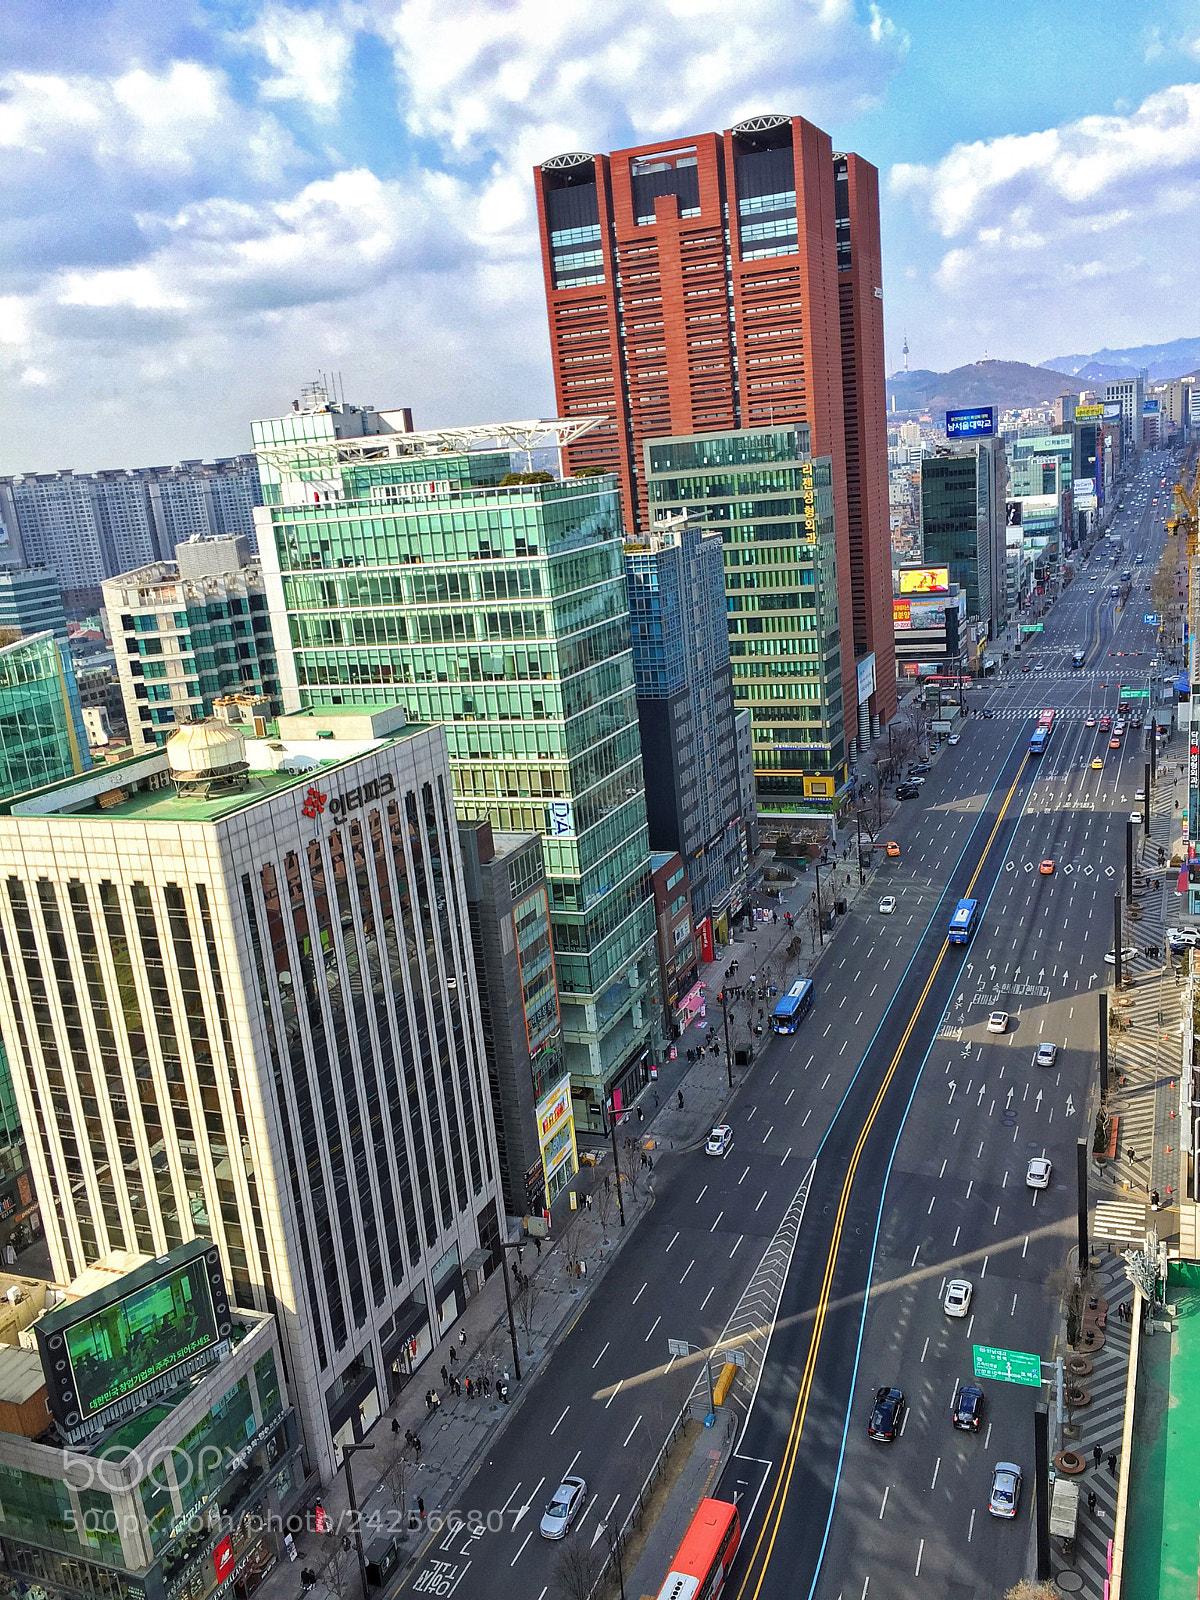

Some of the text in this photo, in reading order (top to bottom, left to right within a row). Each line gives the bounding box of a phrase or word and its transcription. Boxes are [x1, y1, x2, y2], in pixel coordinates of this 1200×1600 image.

[948, 419, 992, 431] 남서울대학교
[802, 463, 817, 545] 리젠성형외과
[329, 773, 397, 826] 인터파크
[89, 1387, 119, 1410] 대한민국
[119, 1365, 156, 1393] 창업기업의
[155, 1351, 177, 1371] 주주가
[412, 1559, 459, 1597] 우회전
